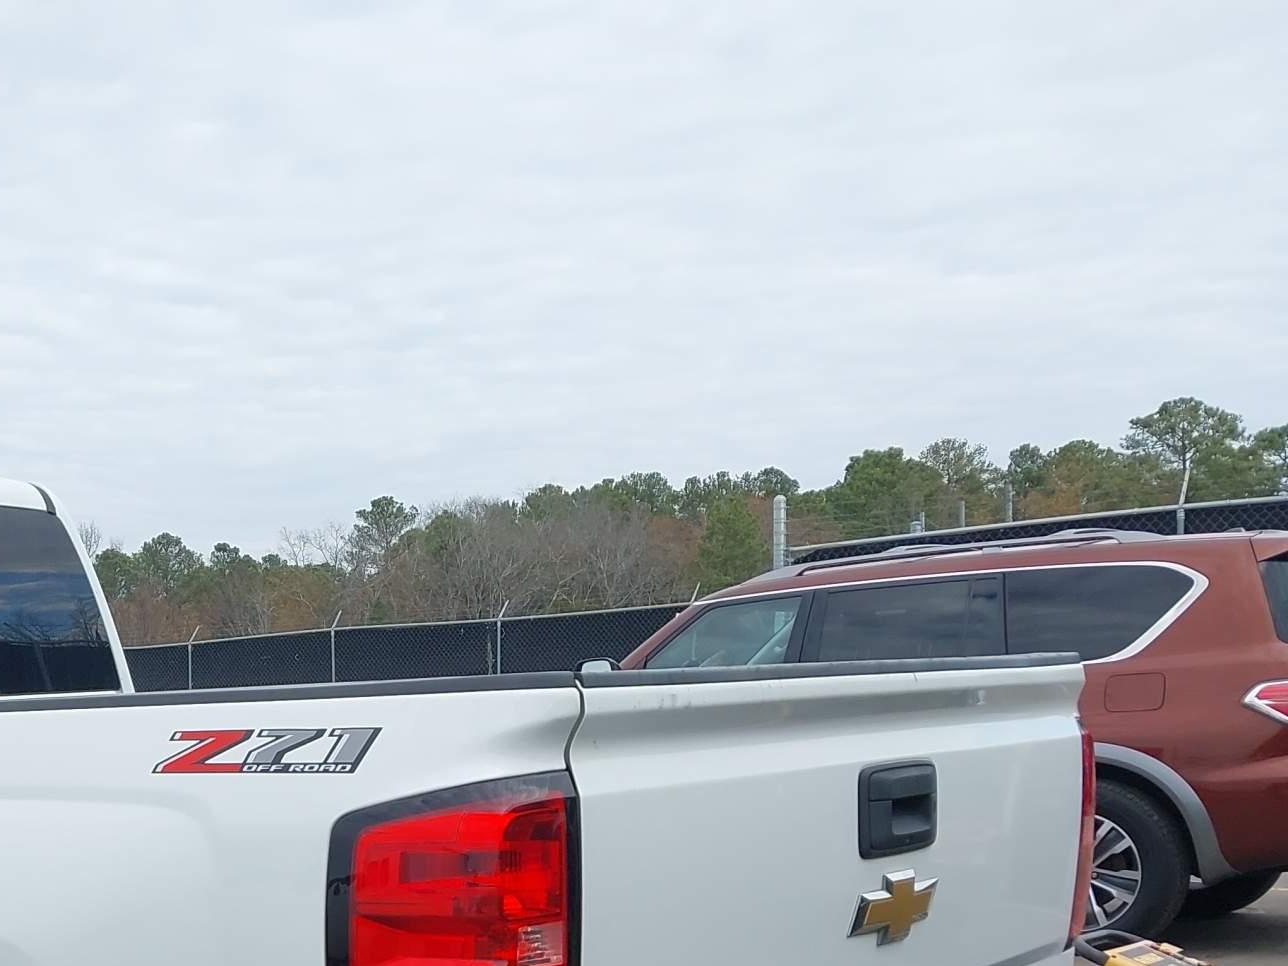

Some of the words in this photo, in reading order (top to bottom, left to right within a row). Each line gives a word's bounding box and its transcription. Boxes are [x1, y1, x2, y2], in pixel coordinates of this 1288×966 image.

[151, 726, 383, 774] Z71
[242, 764, 282, 773] OFF
[288, 763, 352, 773] ROAD
